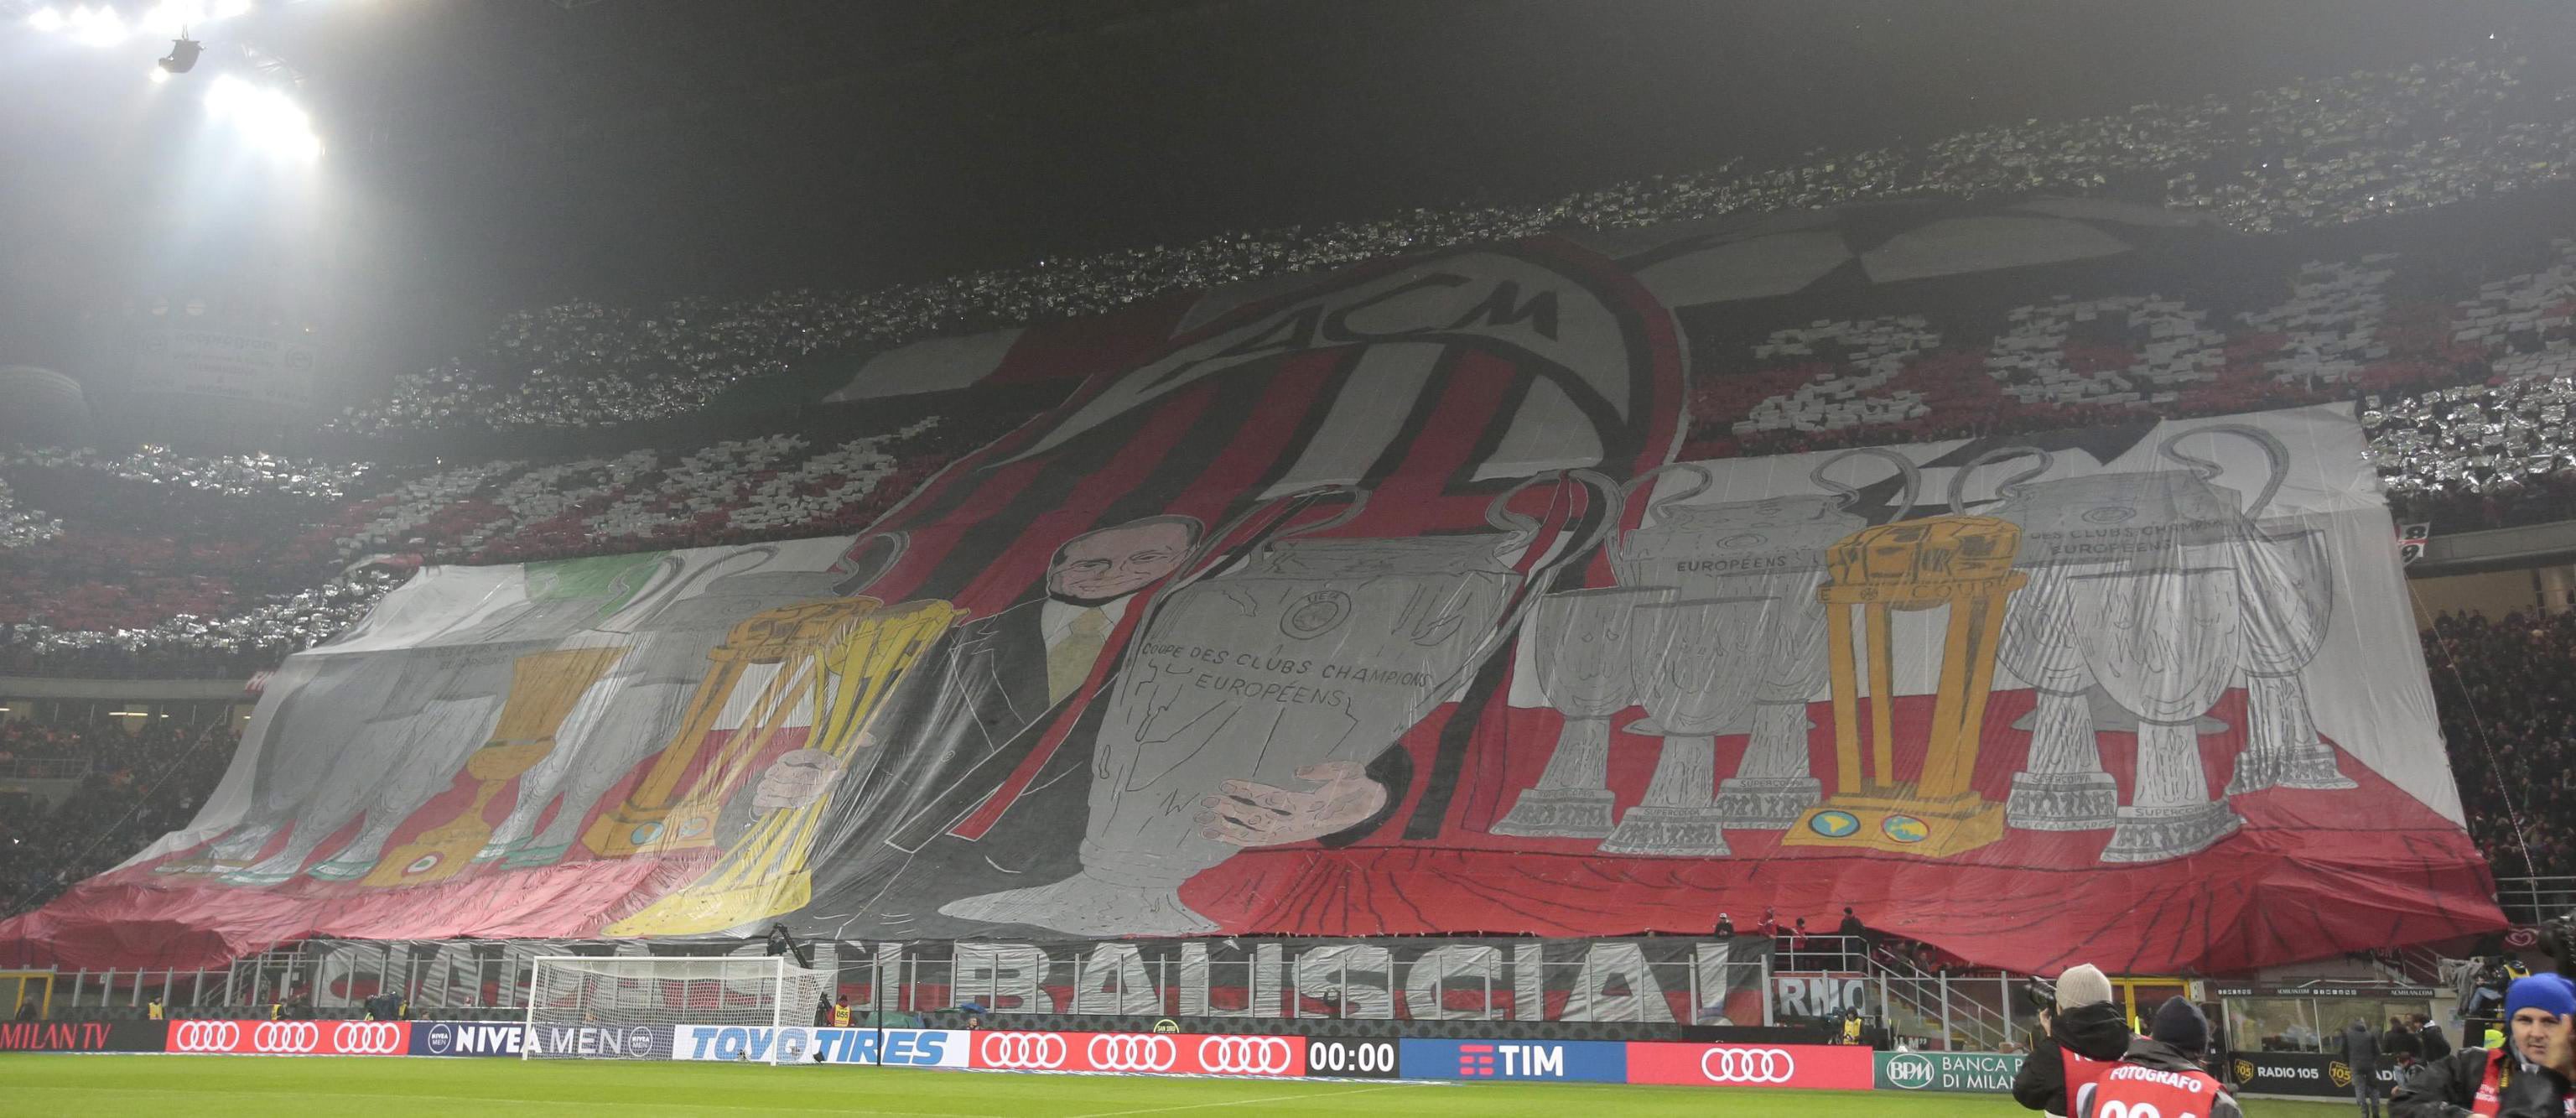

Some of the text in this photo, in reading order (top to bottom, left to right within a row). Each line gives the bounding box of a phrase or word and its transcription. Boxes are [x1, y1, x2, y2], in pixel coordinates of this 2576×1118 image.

[1141, 642, 1432, 689] COUPE DES CLUBS CHAMPIONS
[1194, 673, 1343, 708] EUROPÉENS
[0, 1022, 112, 1049] MILAN TV
[455, 1025, 623, 1055] NIVEA MEN
[692, 1027, 948, 1066] TOYO TIRES
[1309, 1041, 1395, 1073] 00:00
[1498, 1045, 1564, 1077] TIM
[1889, 1060, 1932, 1082] BPM
[1942, 1057, 2007, 1072] BANCA
[1943, 1074, 1960, 1089] DI
[2110, 1064, 2203, 1094] FOTOGRAFO
[2257, 1066, 2319, 1080] RADIO 105
[2331, 1067, 2351, 1080] 105
